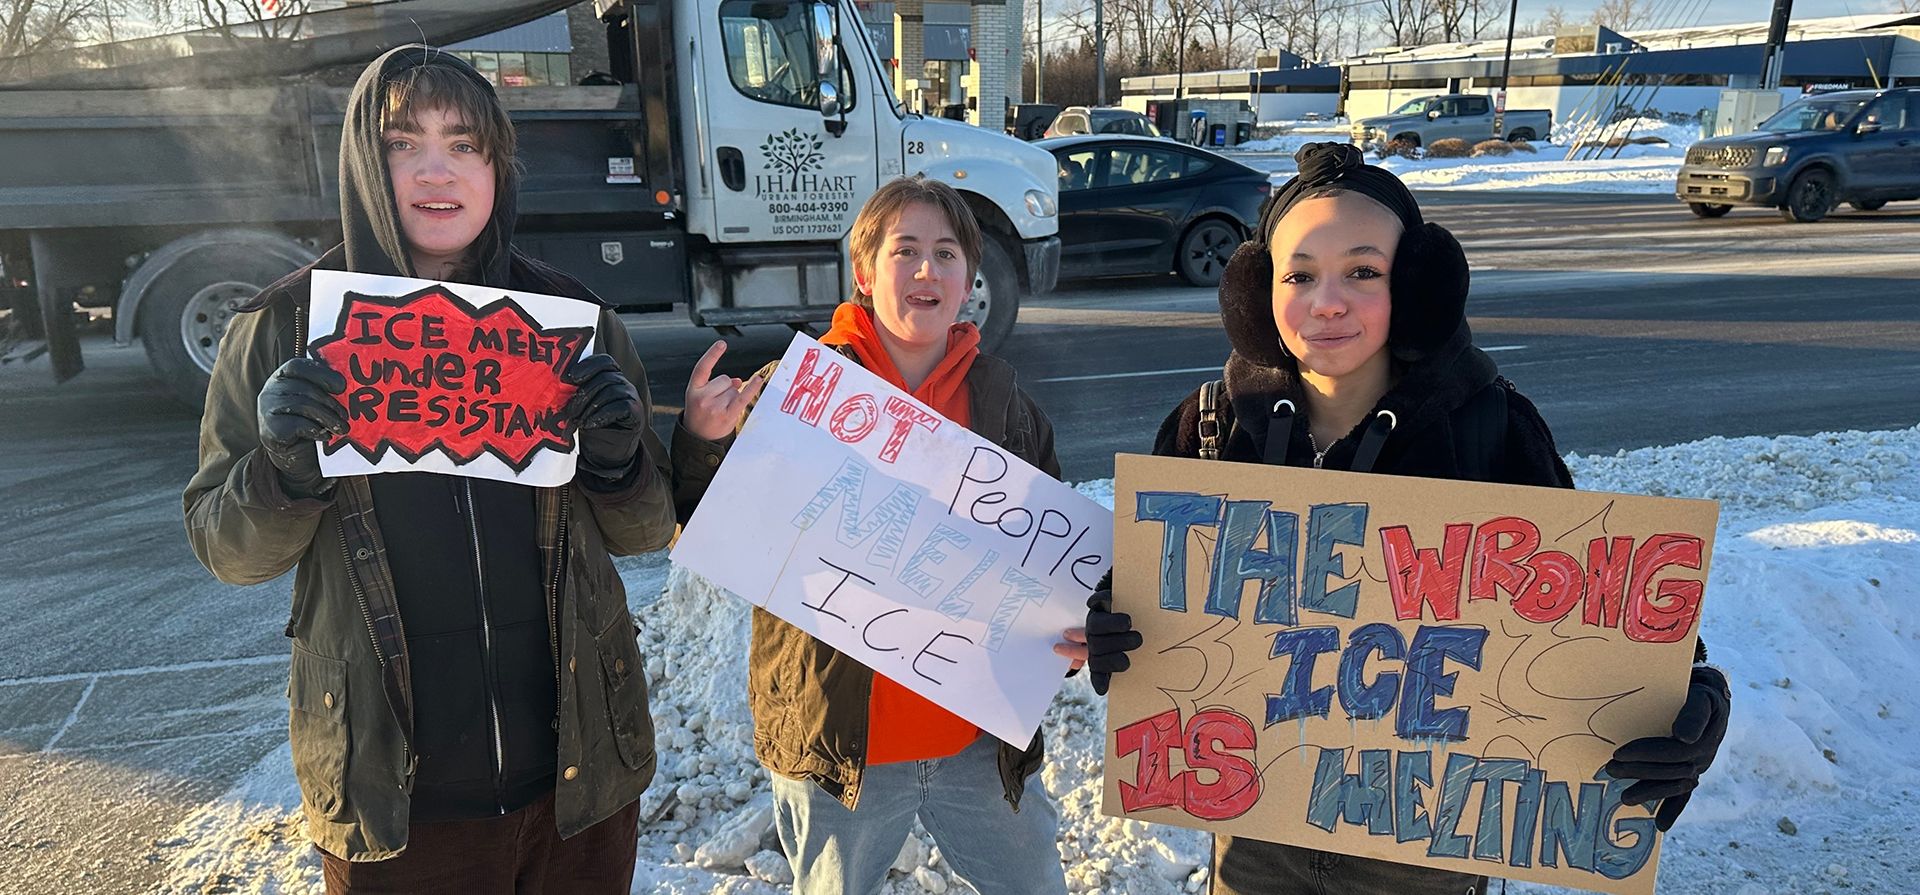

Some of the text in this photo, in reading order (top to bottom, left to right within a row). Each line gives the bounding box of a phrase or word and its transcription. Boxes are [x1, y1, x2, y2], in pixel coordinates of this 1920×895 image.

[908, 141, 924, 155] 28
[755, 174, 857, 199] J.H. HART
[803, 192, 856, 200] FORESTRY
[769, 202, 849, 214] 800-404-9390
[773, 224, 842, 234] US DOT 1737621
[350, 312, 449, 349] ICE
[791, 456, 1055, 653] MELT
[1135, 491, 1704, 643] THE WRONG
[801, 556, 974, 686] I.C.E
[1263, 623, 1490, 742] ICE
[1114, 707, 1658, 880] IS MELTING
